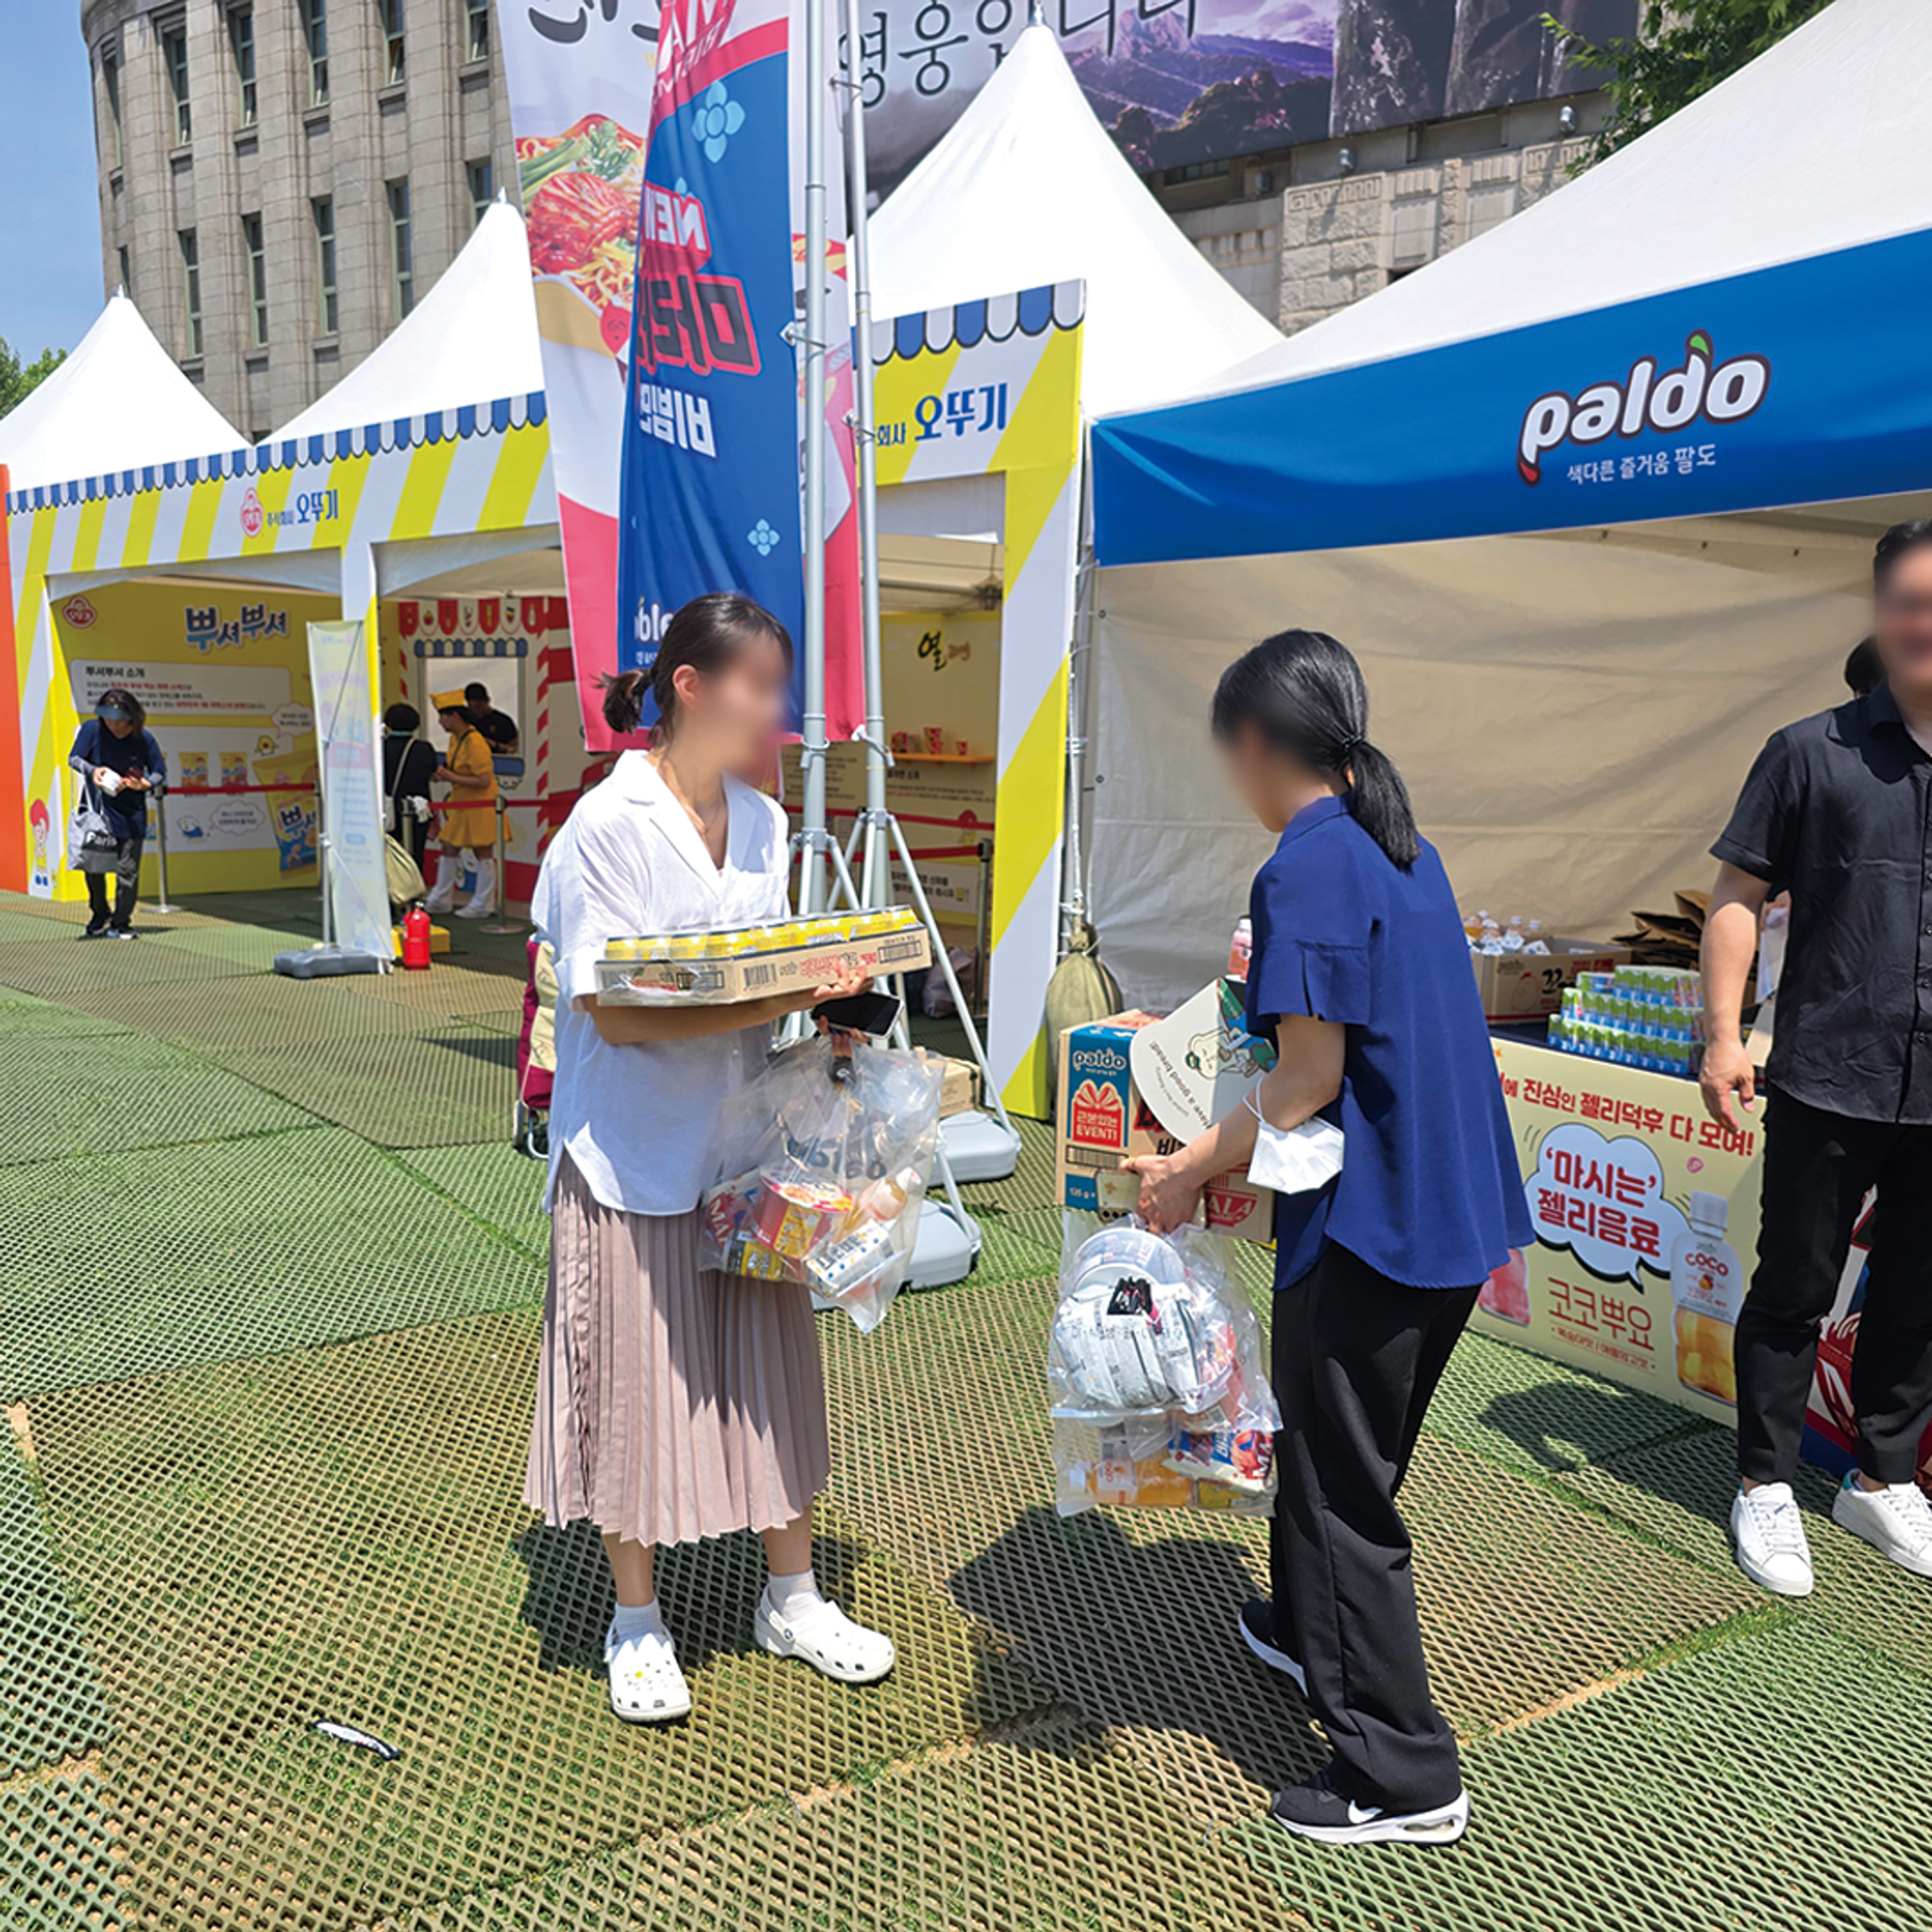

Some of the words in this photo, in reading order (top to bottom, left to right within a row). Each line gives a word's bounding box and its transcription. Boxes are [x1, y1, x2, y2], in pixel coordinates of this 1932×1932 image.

[914, 382, 1008, 441] 오뚜기
[1518, 328, 1771, 486] paldo
[1567, 459, 1615, 485] 색다른
[1619, 450, 1670, 480] 즐거움
[1674, 444, 1717, 474] 팔도
[296, 489, 339, 523] 오뚜기
[184, 603, 287, 652] 뿌셔뿌셔
[1073, 1046, 1127, 1072] paldo
[1169, 1071, 1191, 1097] good
[1523, 1078, 1576, 1114] 진심인
[1580, 1092, 1664, 1135] 젤리덕후
[1669, 1114, 1694, 1143] 다
[1699, 1122, 1755, 1157] 모여!
[1208, 1193, 1253, 1216] ALA
[1538, 1187, 1661, 1258] 젤리음료
[1684, 1251, 1730, 1277] COCO
[1548, 1276, 1656, 1351] 코코뿌요
